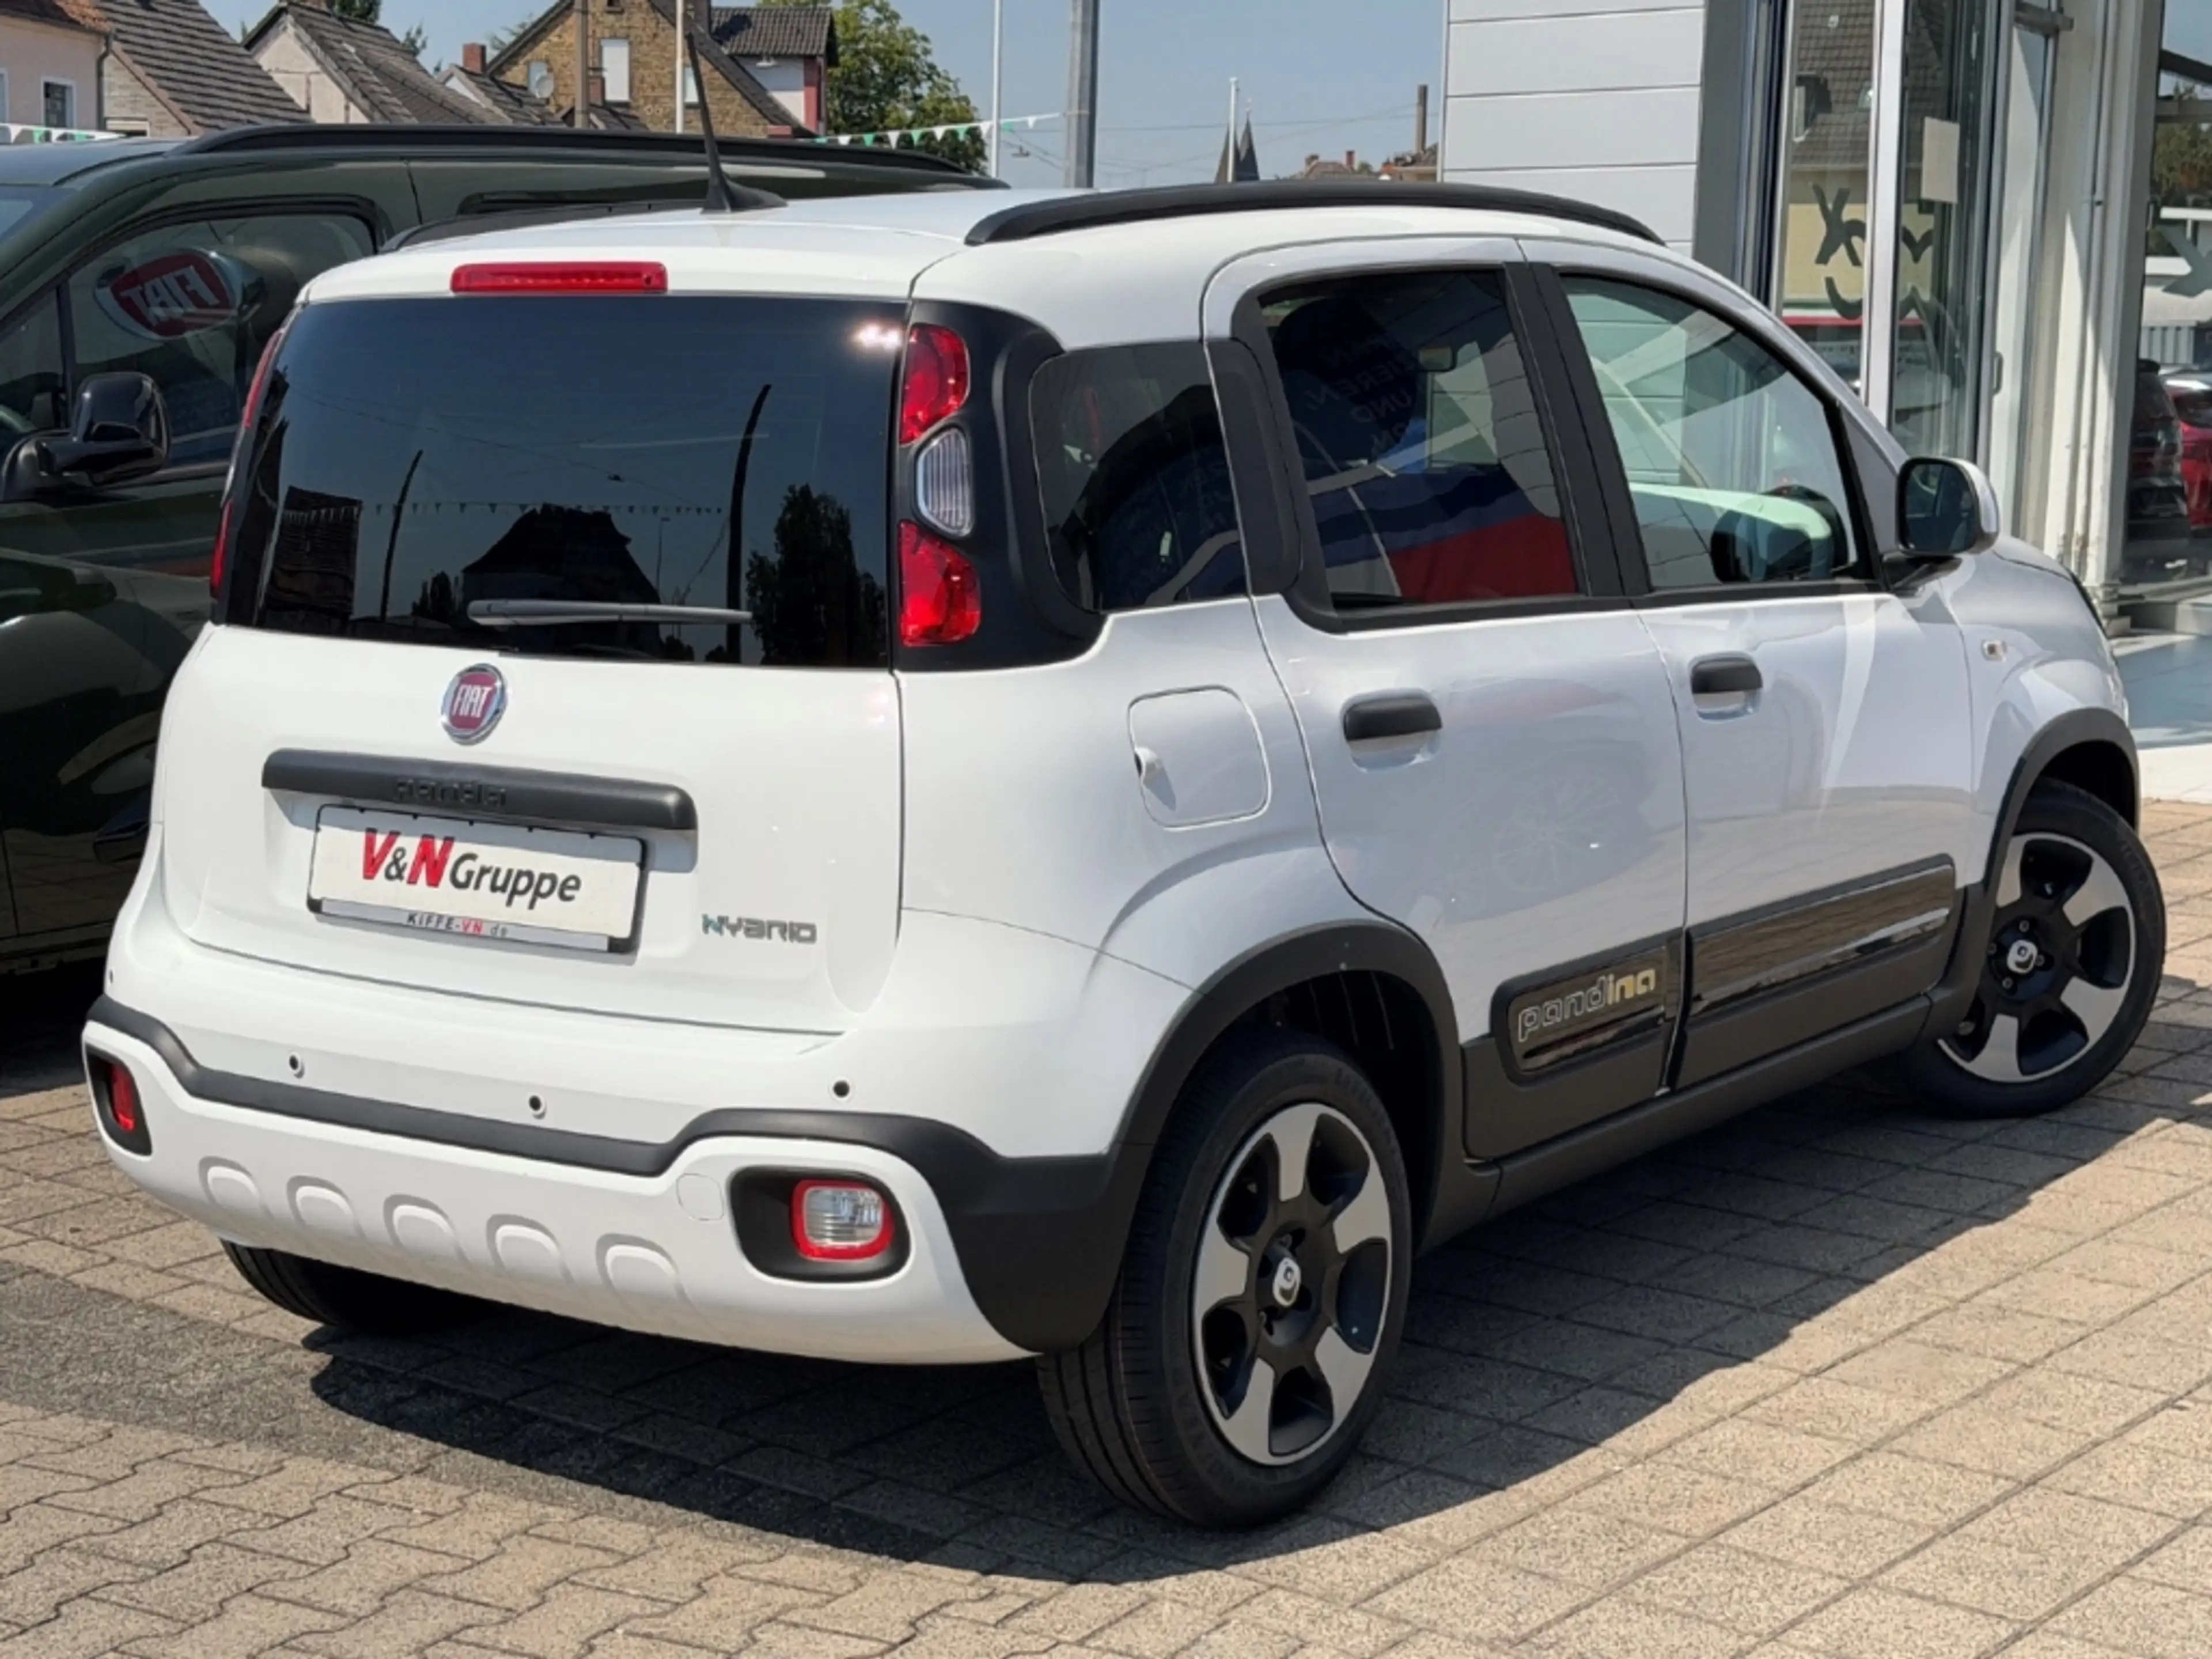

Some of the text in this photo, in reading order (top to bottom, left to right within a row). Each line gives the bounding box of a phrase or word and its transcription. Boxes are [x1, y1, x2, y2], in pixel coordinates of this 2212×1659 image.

[452, 683, 493, 718] FIAT
[394, 778, 507, 807] panda
[362, 827, 582, 910] V&N Gruppe
[702, 914, 817, 945] HYBRID
[1518, 968, 1656, 1043] pandina
